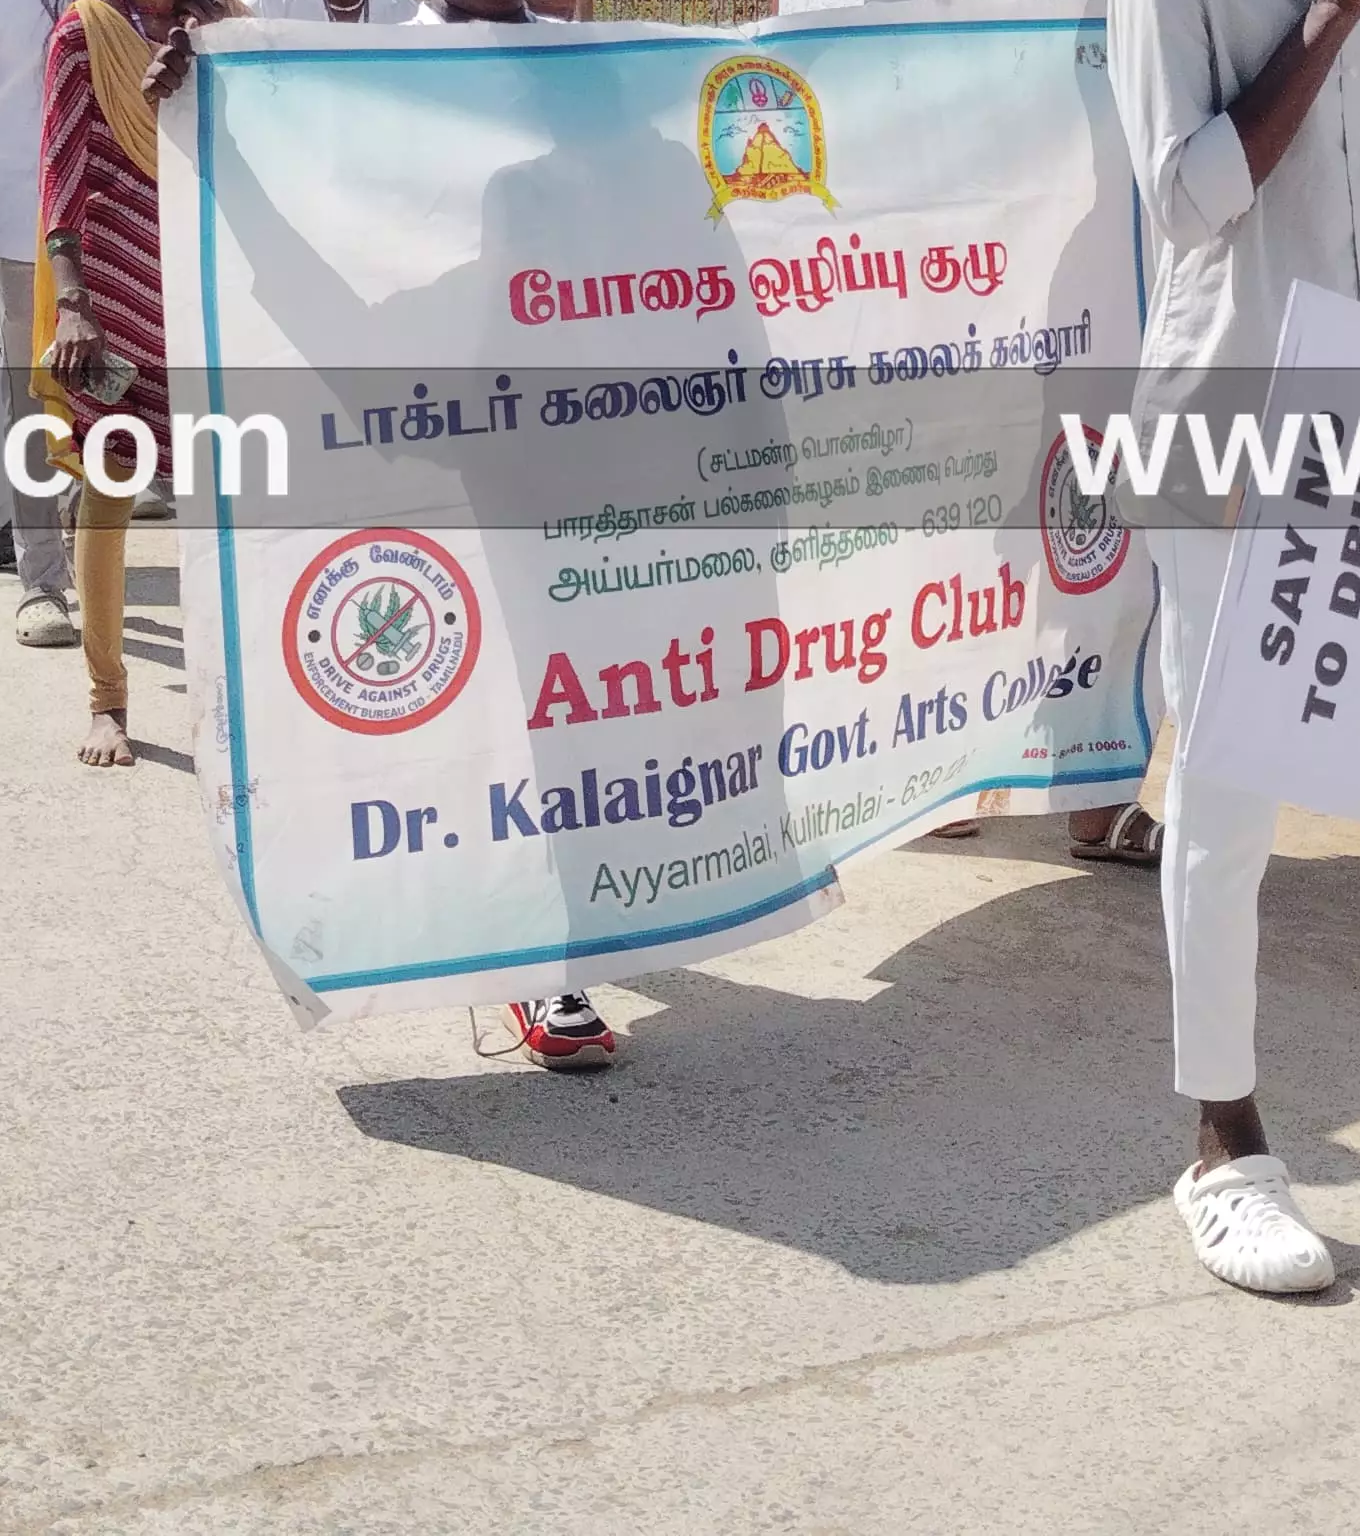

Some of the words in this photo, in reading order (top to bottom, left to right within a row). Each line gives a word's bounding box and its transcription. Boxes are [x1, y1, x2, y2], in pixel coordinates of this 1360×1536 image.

[509, 261, 736, 325] போதை
[749, 232, 907, 317] ஒழிப்பு
[920, 240, 1008, 297] குழு
[321, 373, 523, 451] டாக்டர்
[540, 348, 748, 427] கலைஞர்
[760, 355, 857, 402] அரசு
[868, 322, 983, 386] கலைக்
[989, 308, 1092, 376] கல்லூரி
[543, 494, 696, 544] பாரதிதாசன்
[704, 467, 861, 520] பல்கலைக்கழகம்
[864, 461, 942, 498] இணைவு
[548, 547, 762, 603] அய்யர்மலை,
[770, 520, 899, 574] குளித்தலை
[921, 501, 962, 539] 639
[965, 494, 1003, 528] 120
[306, 556, 360, 621] எனக்கு
[369, 544, 457, 602] வேண்டாம்
[1260, 523, 1319, 666] SAY
[303, 652, 362, 717] ENFORCEMENT
[360, 706, 407, 720] BUREAU
[408, 695, 427, 713] CID
[429, 631, 465, 695] TAMILNADU
[319, 656, 355, 695] DRIVE
[357, 679, 419, 703] AGAINST
[422, 636, 452, 683] DRUGS
[527, 626, 720, 730] Anti
[744, 607, 892, 692] Drug
[911, 561, 1026, 650] Club
[1301, 641, 1348, 724] TO
[350, 799, 460, 862] Dr.
[488, 744, 763, 843] Kalaignar
[777, 707, 878, 778] Govt.
[891, 684, 968, 749] Arts
[590, 823, 779, 909] Ayyarmalai,
[779, 785, 886, 850] Kulithalai
